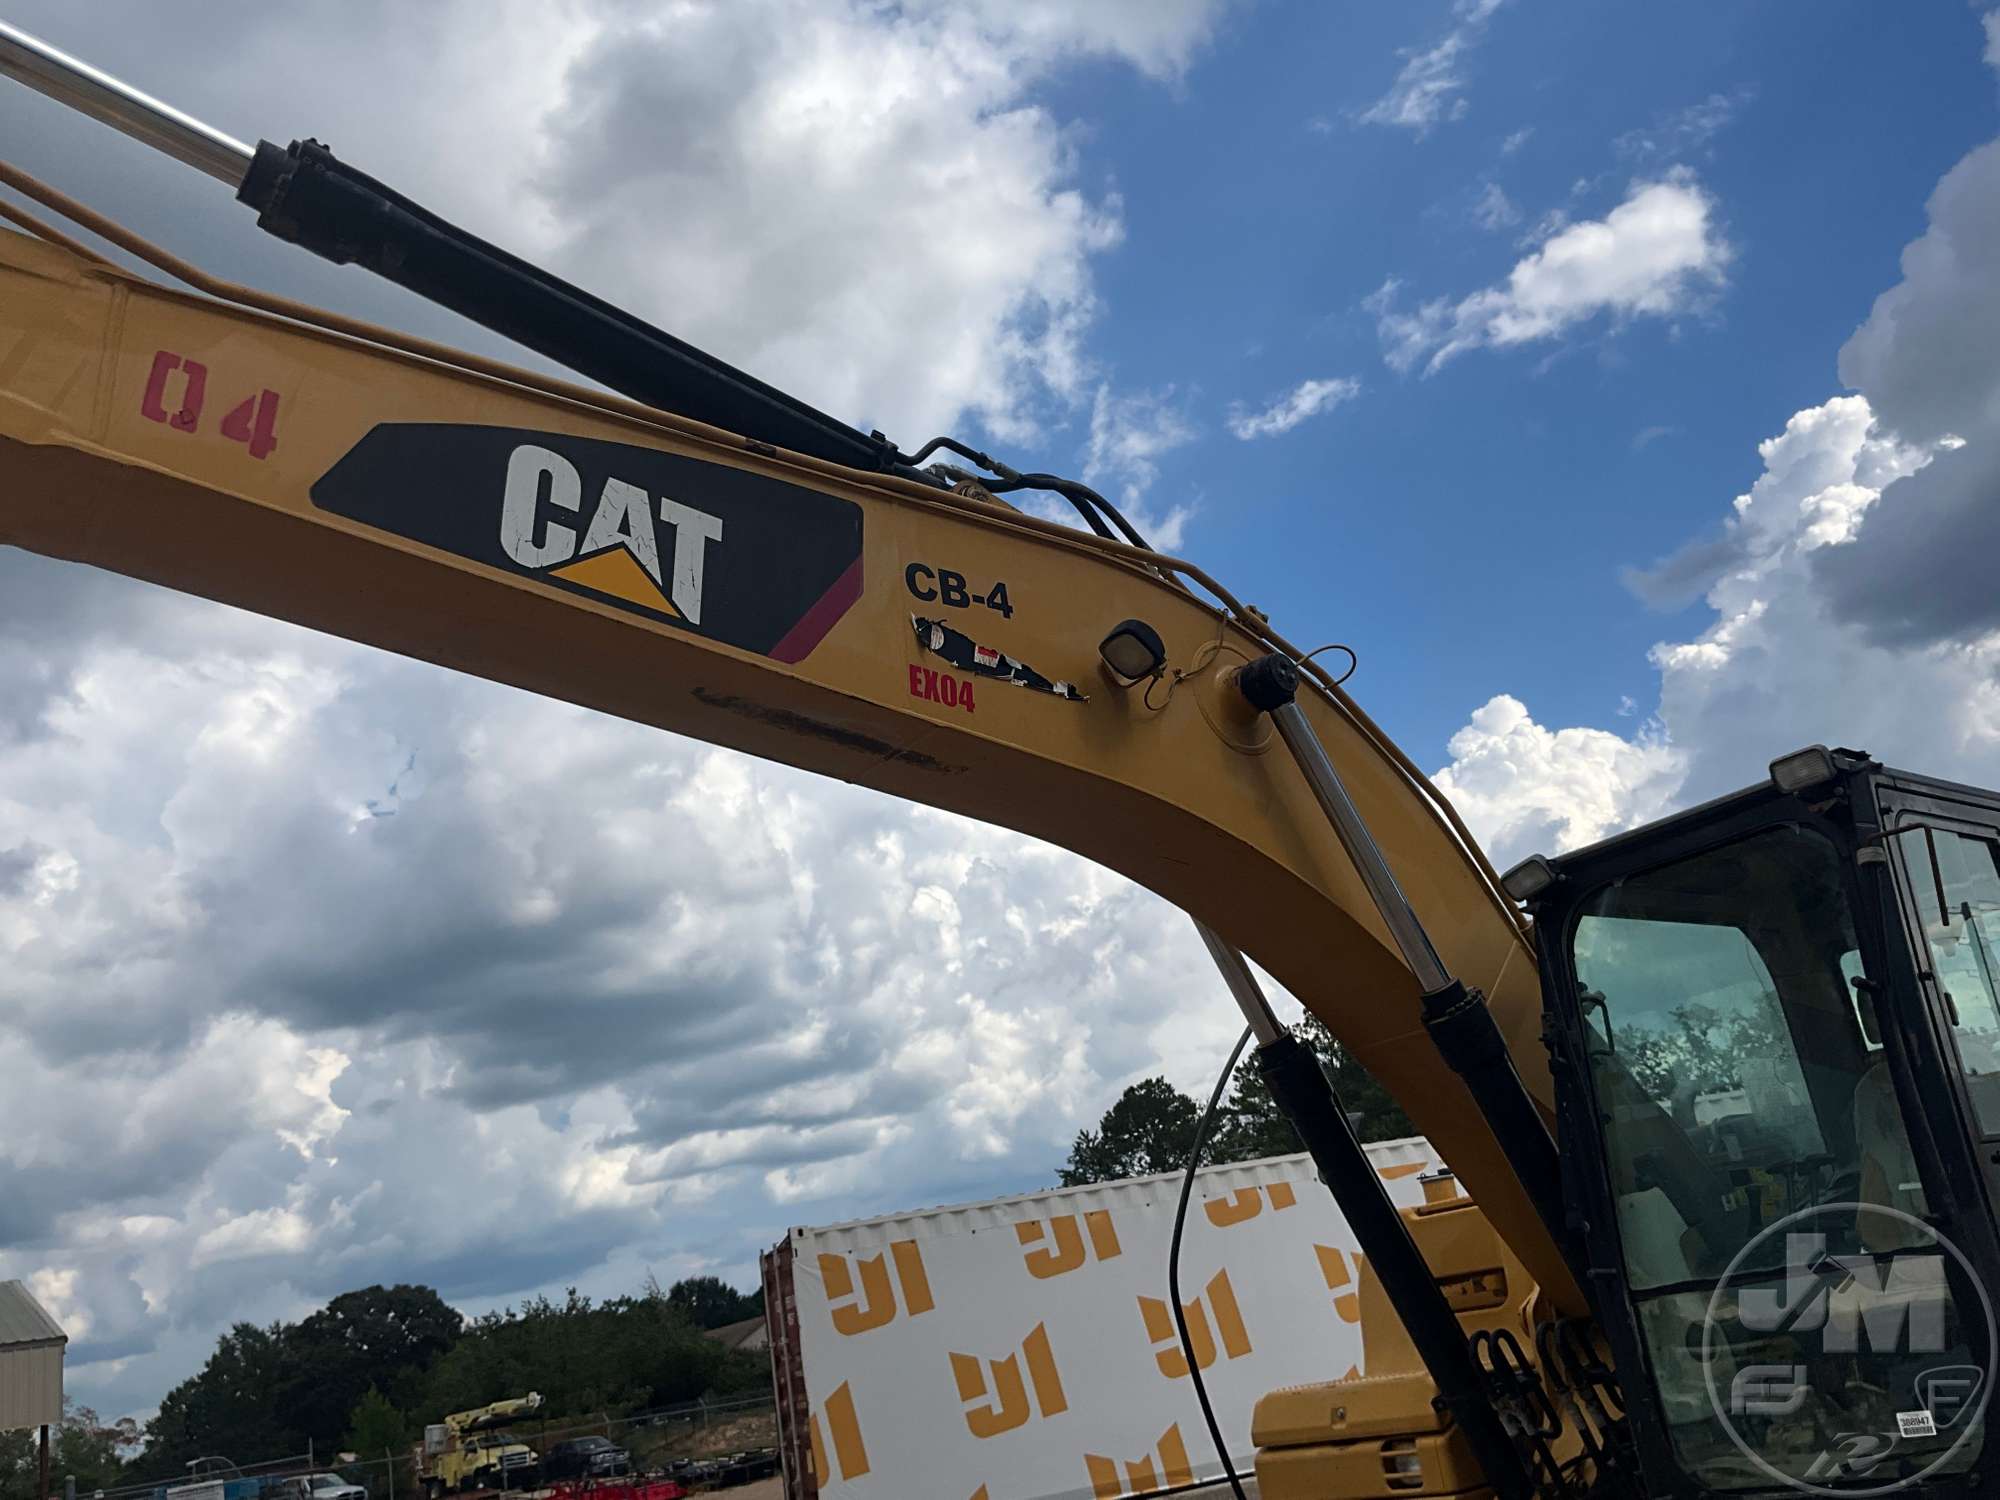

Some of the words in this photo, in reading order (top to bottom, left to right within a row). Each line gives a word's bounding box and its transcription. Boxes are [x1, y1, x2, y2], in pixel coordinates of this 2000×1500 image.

[500, 444, 723, 625] CAT
[905, 562, 1014, 619] CB-4
[909, 664, 976, 713] EX04
